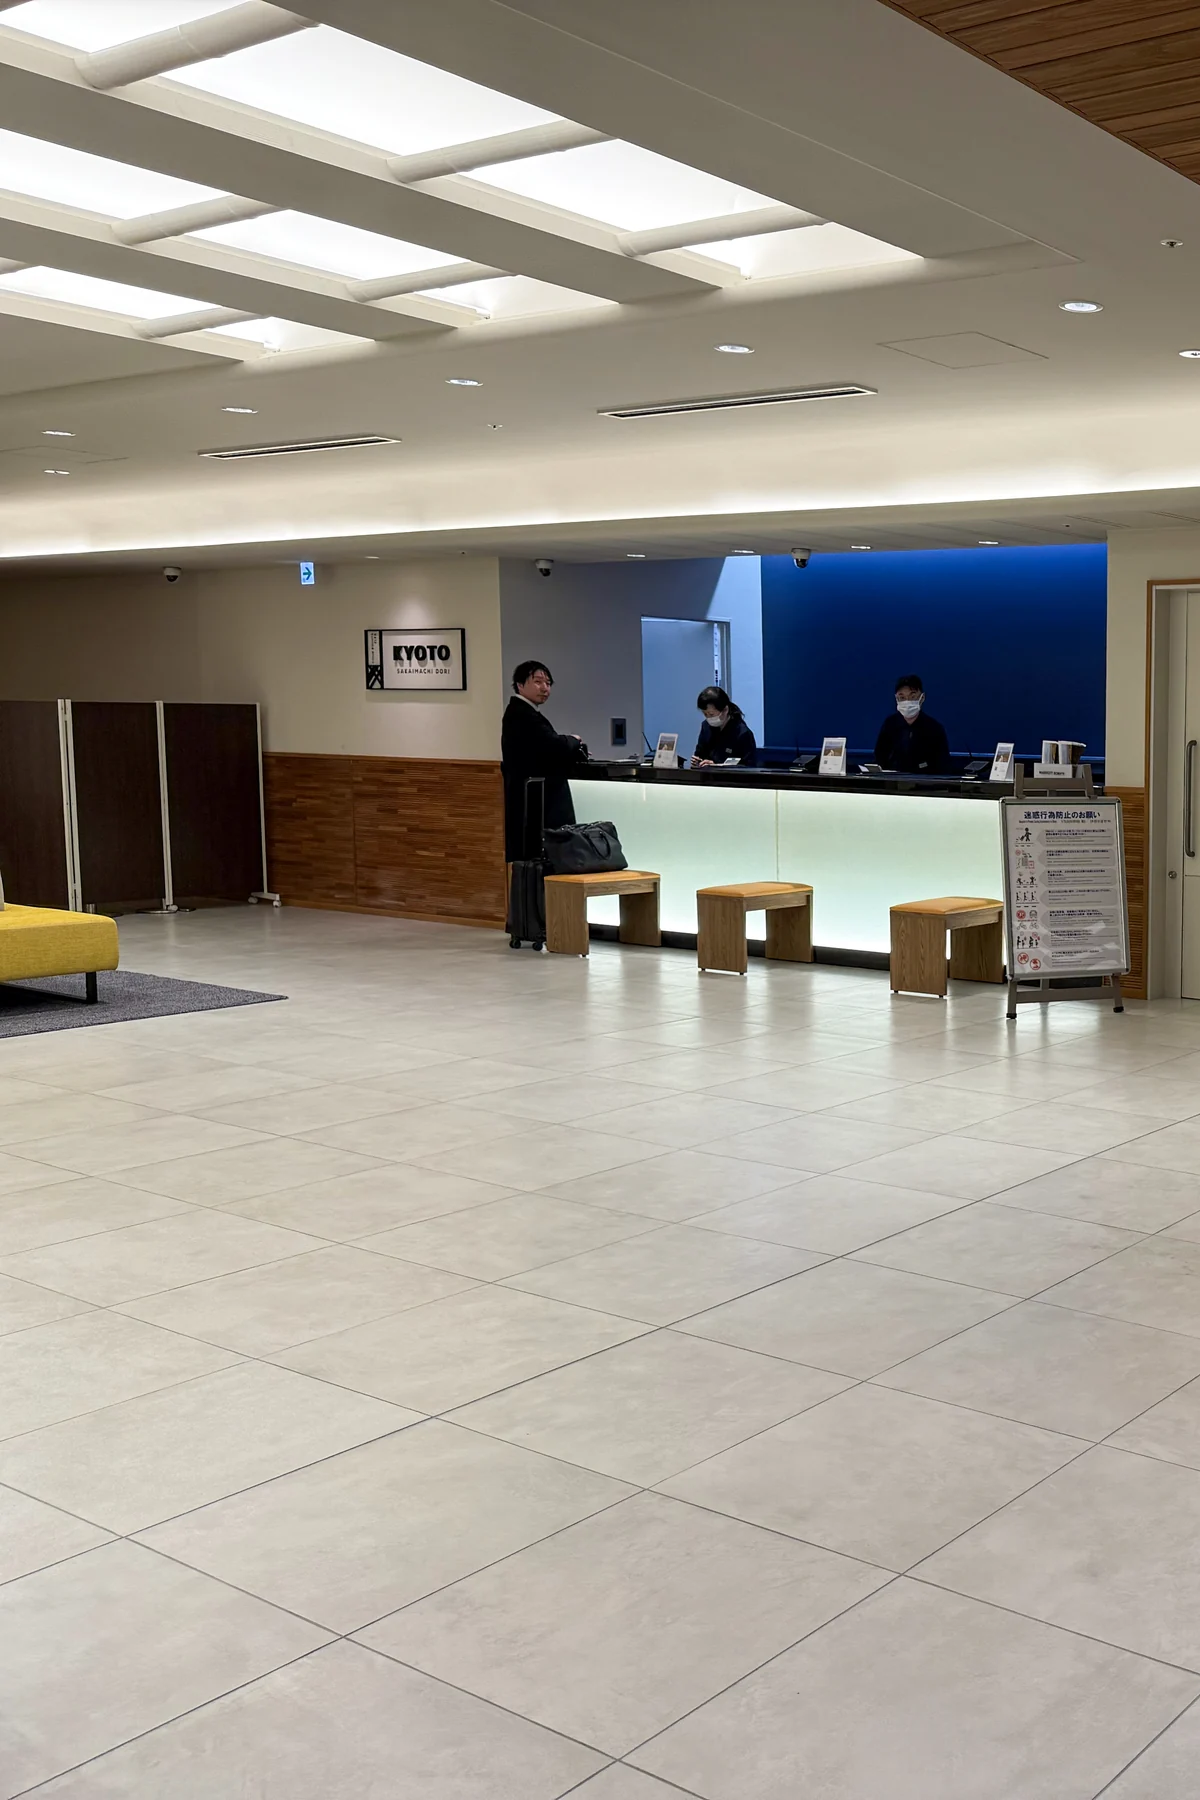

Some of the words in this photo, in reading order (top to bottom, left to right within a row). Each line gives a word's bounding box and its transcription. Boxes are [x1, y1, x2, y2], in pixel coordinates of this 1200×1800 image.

[393, 645, 450, 661] KYOTO
[1024, 811, 1101, 819] 迷惑行為防止のお願い
